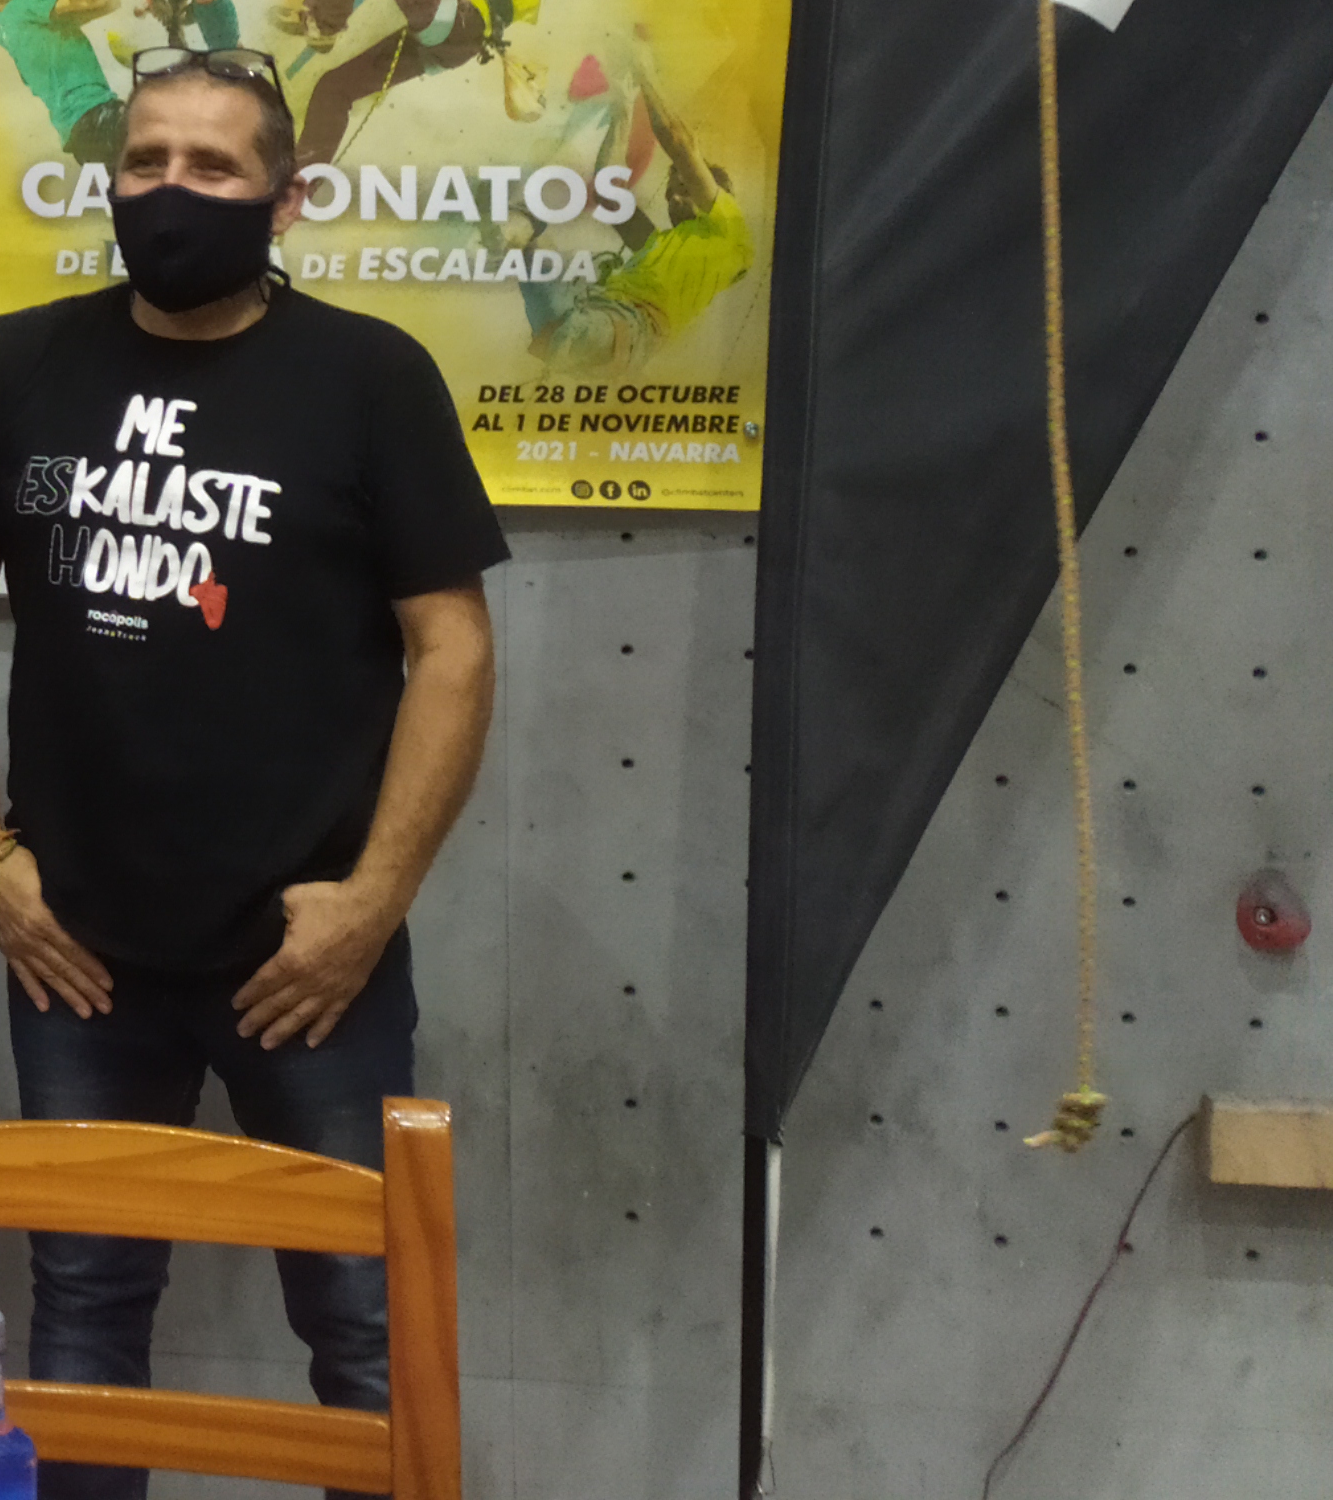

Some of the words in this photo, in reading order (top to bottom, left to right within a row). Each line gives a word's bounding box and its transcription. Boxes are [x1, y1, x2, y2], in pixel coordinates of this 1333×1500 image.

[55, 249, 99, 276] DE
[301, 253, 345, 279] DE
[357, 246, 597, 284] ESCALADA
[478, 386, 525, 404] DEL
[535, 385, 565, 404] 28
[574, 386, 608, 404] DE
[617, 385, 740, 404] OCTUBRE
[115, 394, 197, 457] ME
[472, 414, 504, 432] AL
[517, 414, 525, 432] 1
[537, 414, 571, 432] DE
[579, 414, 740, 434] NOVIEMBRE
[516, 441, 578, 462] 2021
[609, 441, 741, 465] NAVARRA
[16, 456, 282, 544] ESKALASTE
[48, 523, 213, 607] HONDO
